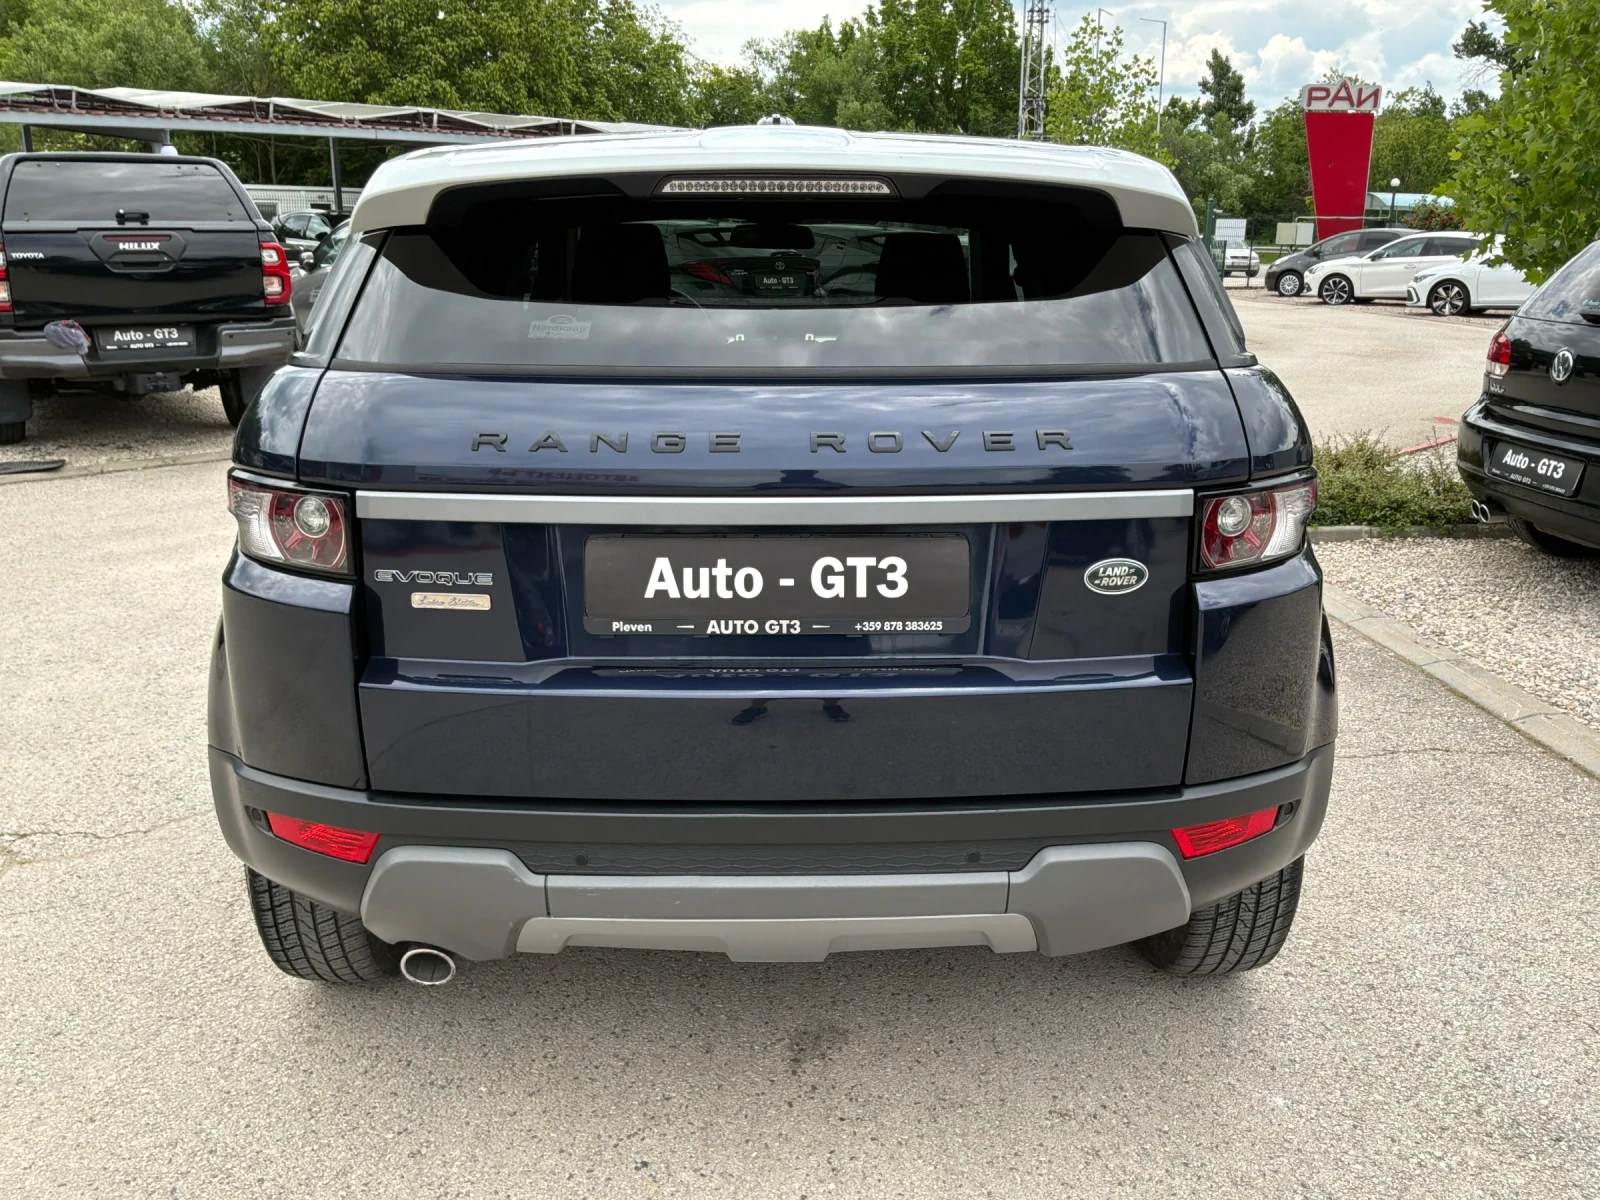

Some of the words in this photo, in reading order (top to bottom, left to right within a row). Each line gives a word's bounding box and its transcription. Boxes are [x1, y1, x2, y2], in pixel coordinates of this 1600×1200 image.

[119, 242, 160, 250] HILUX
[763, 276, 777, 284] Auto
[782, 276, 794, 284] GT3
[114, 330, 143, 341] Auto
[154, 328, 179, 339] GT3
[471, 430, 742, 453] RANGE
[809, 429, 1074, 453] ROVER
[1502, 448, 1529, 469] Auto
[1537, 458, 1565, 479] GT3
[374, 569, 493, 586] EVOQUE
[644, 556, 763, 599] Auto
[810, 556, 909, 599] GT3
[1098, 566, 1129, 577] LAND
[1100, 575, 1138, 586] ROVER
[612, 621, 652, 632] Pleven
[706, 619, 759, 634] AUTO
[764, 619, 801, 634] GT3
[854, 621, 882, 631] +359
[883, 621, 903, 631] 878
[905, 621, 943, 631] 383625
